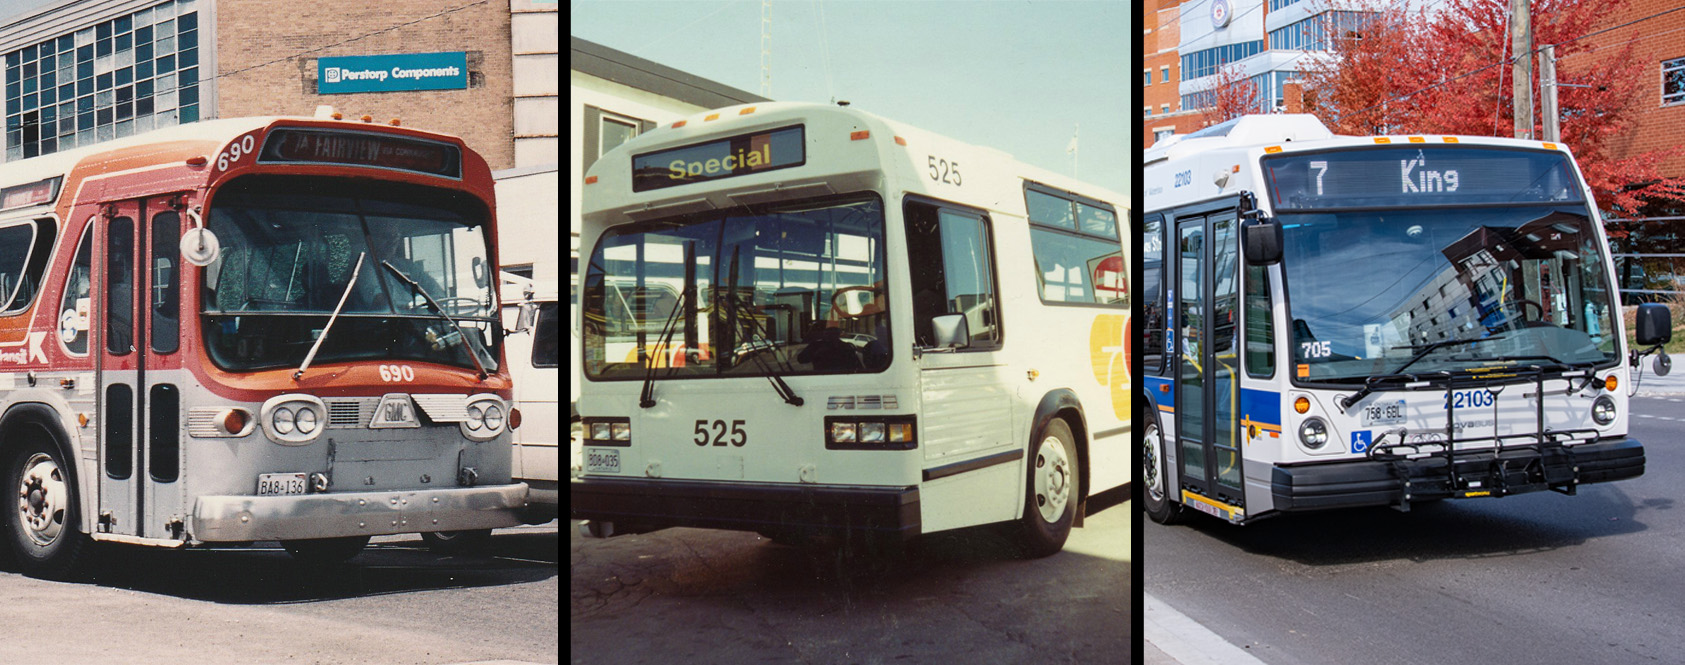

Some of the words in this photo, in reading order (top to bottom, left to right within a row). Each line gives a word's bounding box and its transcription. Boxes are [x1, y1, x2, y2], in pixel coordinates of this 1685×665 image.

[341, 68, 389, 82] Perstorp
[391, 65, 460, 80] Components
[217, 134, 255, 172] 690
[313, 136, 381, 161] FAIRVIEW
[668, 143, 771, 180] Special
[928, 155, 962, 187] 525
[1309, 160, 1328, 196] 7
[1400, 158, 1459, 194] King
[1302, 340, 1332, 359] 705
[379, 364, 415, 382] 690
[384, 402, 408, 422] GMC
[693, 419, 748, 447] 525
